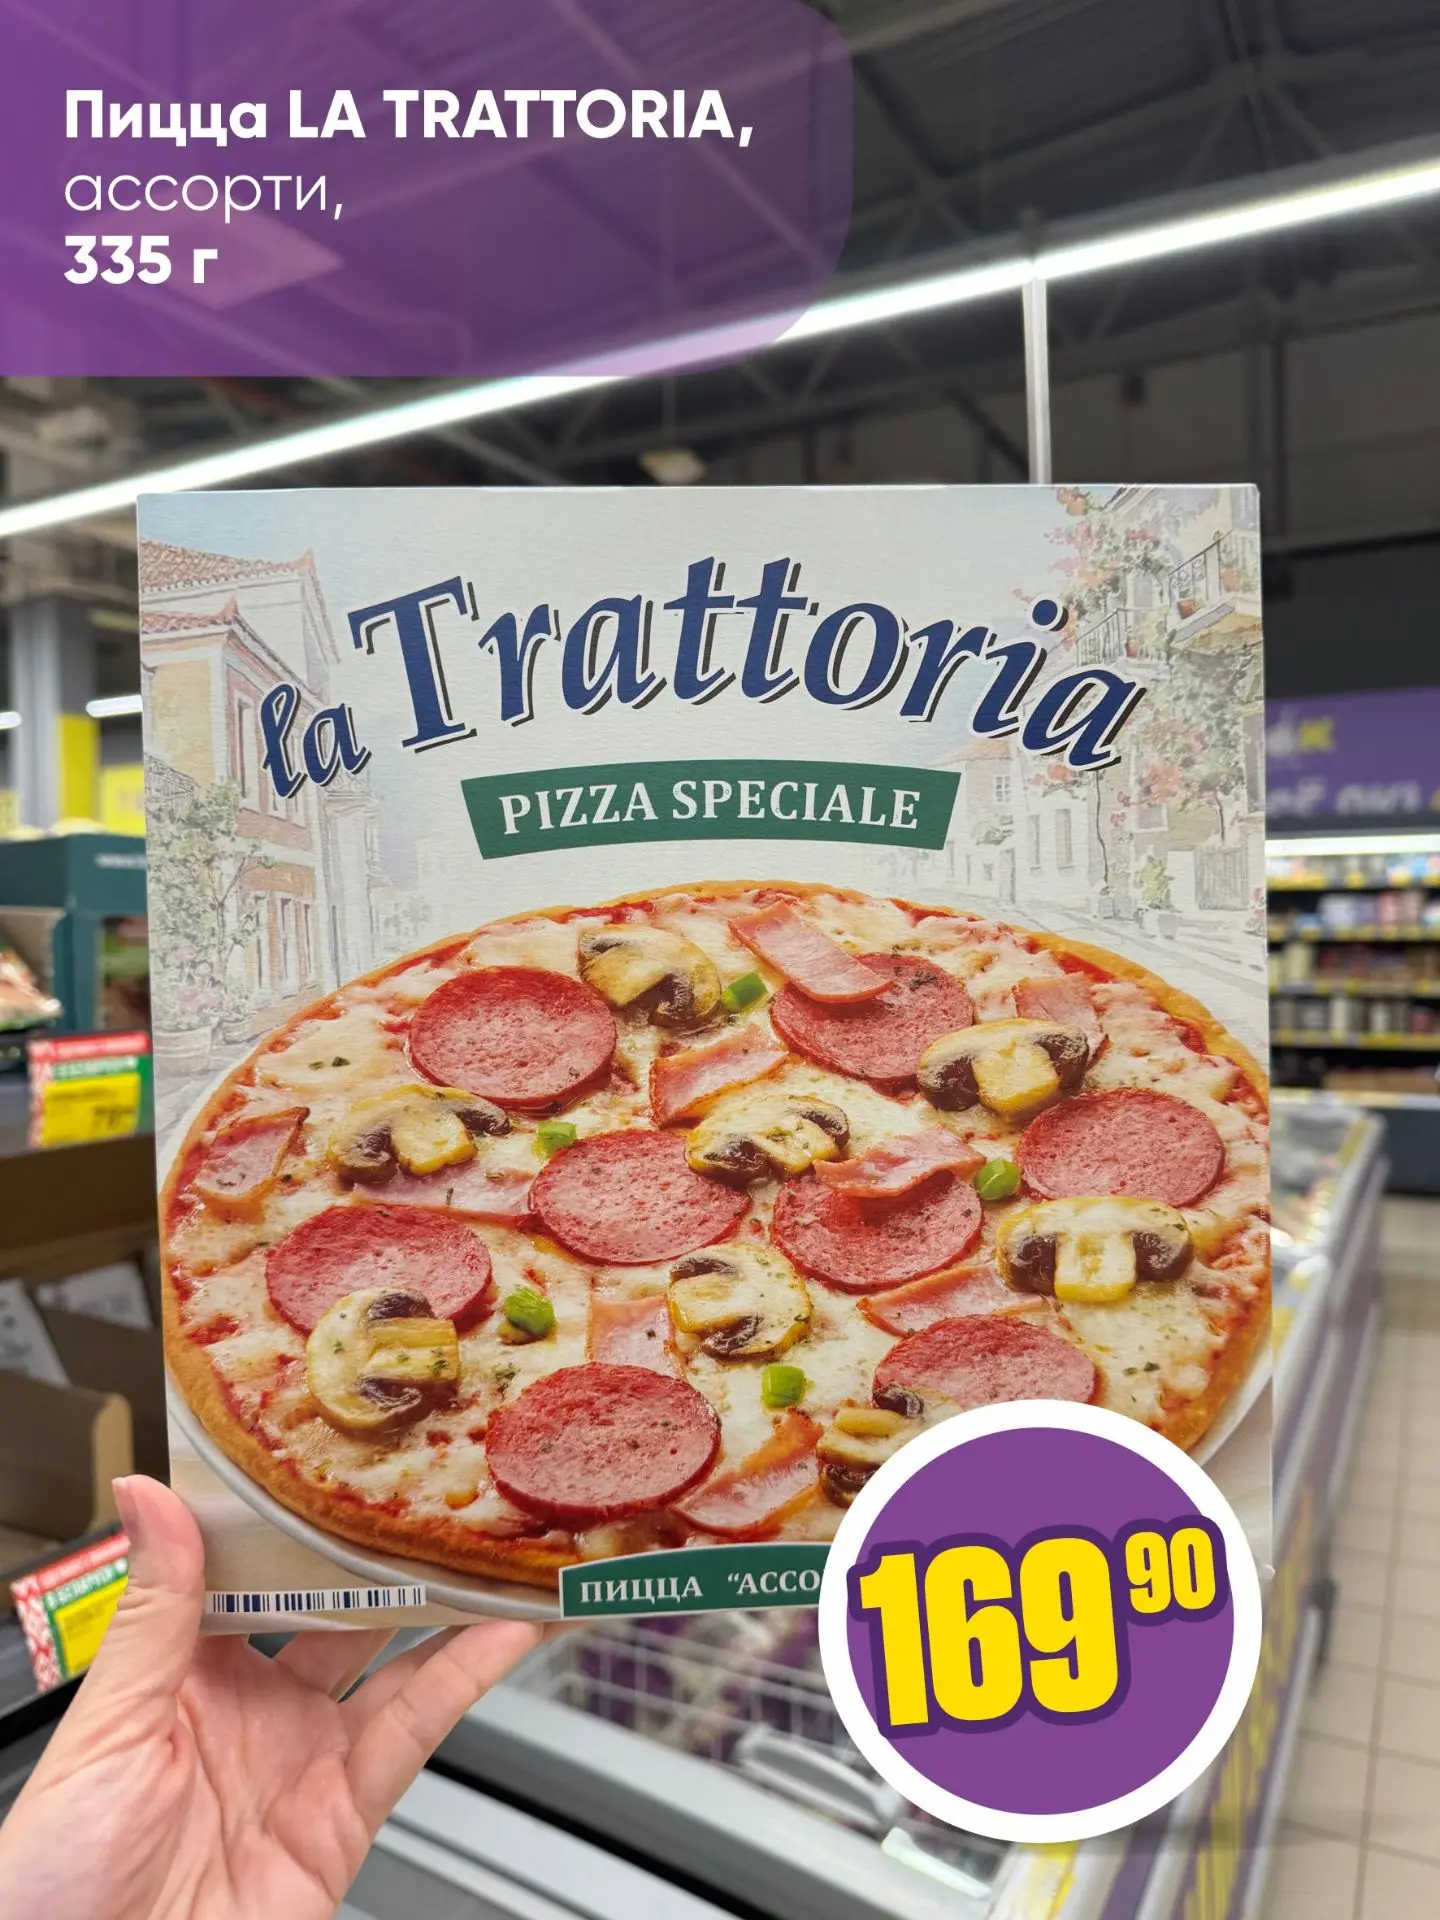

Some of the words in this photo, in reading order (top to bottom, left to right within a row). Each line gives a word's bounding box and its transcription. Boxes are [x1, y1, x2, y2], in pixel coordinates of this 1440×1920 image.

[261, 683, 371, 798] la
[347, 556, 1146, 770] Trattoria
[498, 781, 659, 836] PIZZA
[672, 779, 922, 830] SPECIALE
[580, 1575, 704, 1604] ПИЦЦА
[727, 1569, 823, 1596] “АССО
